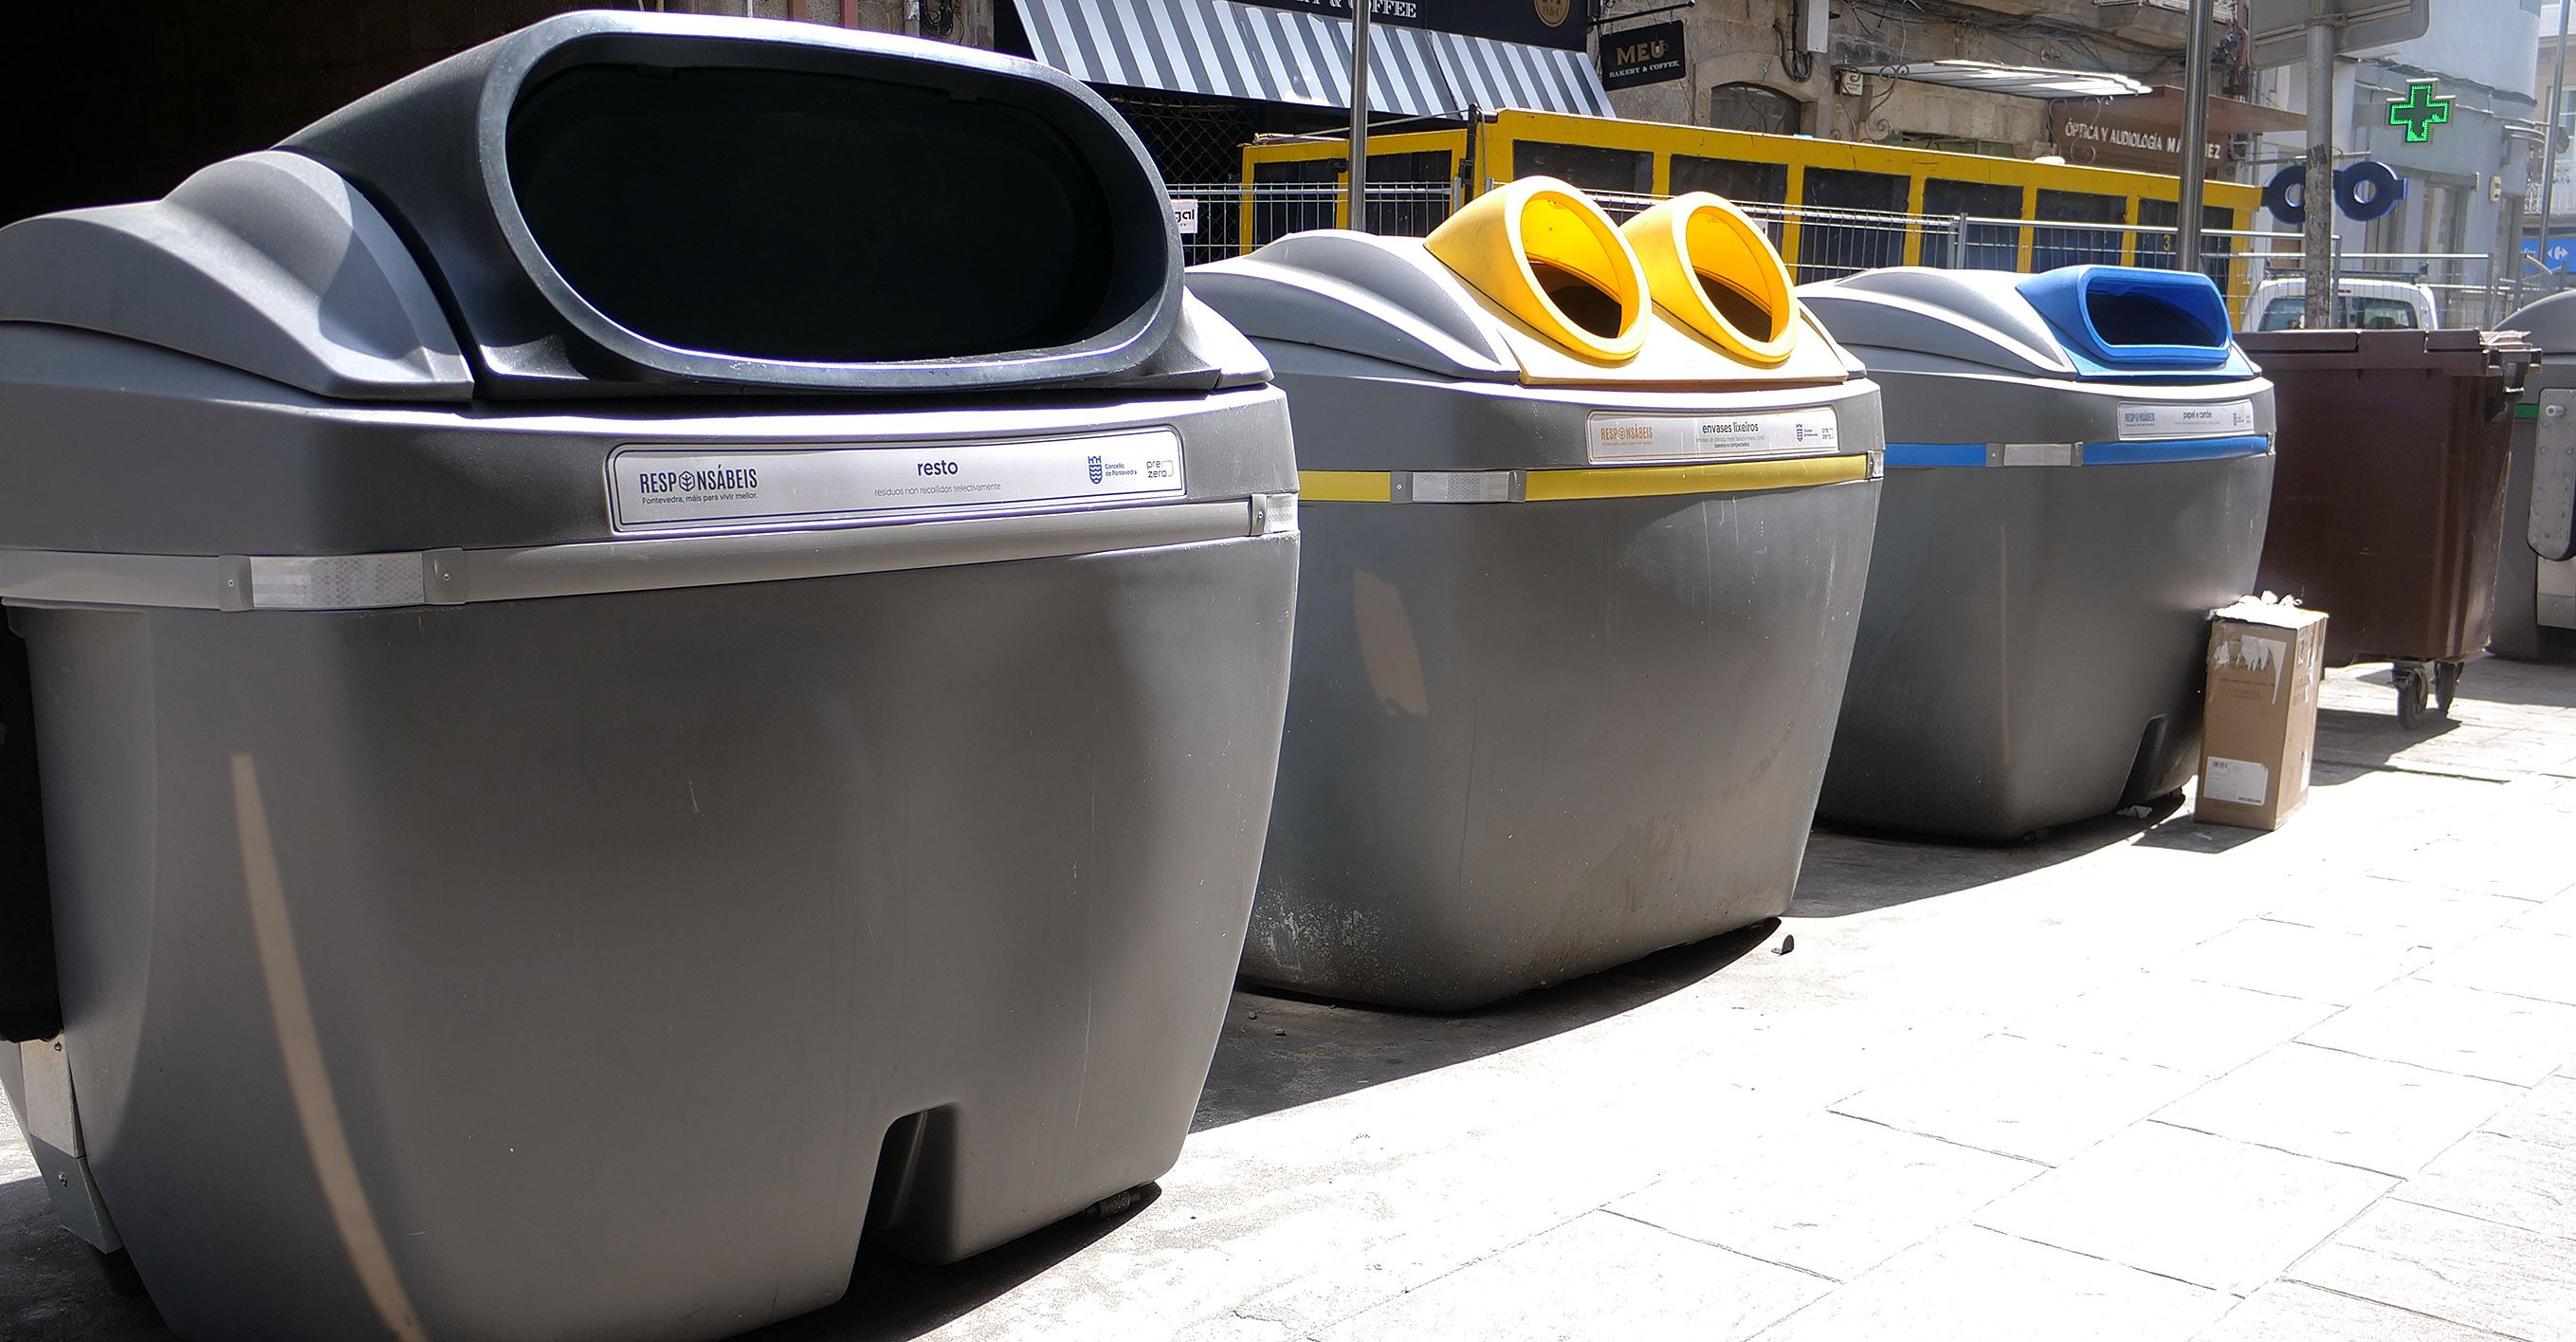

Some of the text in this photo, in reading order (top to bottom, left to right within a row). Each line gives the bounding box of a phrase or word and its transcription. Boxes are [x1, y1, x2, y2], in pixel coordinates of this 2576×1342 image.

[1348, 0, 1416, 18] FFEE
[1617, 39, 1667, 65] MEU
[1609, 66, 1641, 79] BAKERY
[1650, 60, 1680, 72] COFFEE
[2065, 117, 2099, 141] ÓPTICA
[2101, 126, 2109, 142] Y
[2110, 129, 2162, 151] AUDIOLOGÍA
[1702, 421, 1759, 433] envases lixeiros
[917, 459, 959, 476] resto
[1146, 460, 1160, 470] pre
[1147, 469, 1167, 478] zero
[642, 494, 685, 505] Pontevedra,
[703, 494, 719, 503] para
[719, 492, 735, 501] vivir
[904, 487, 919, 495] non
